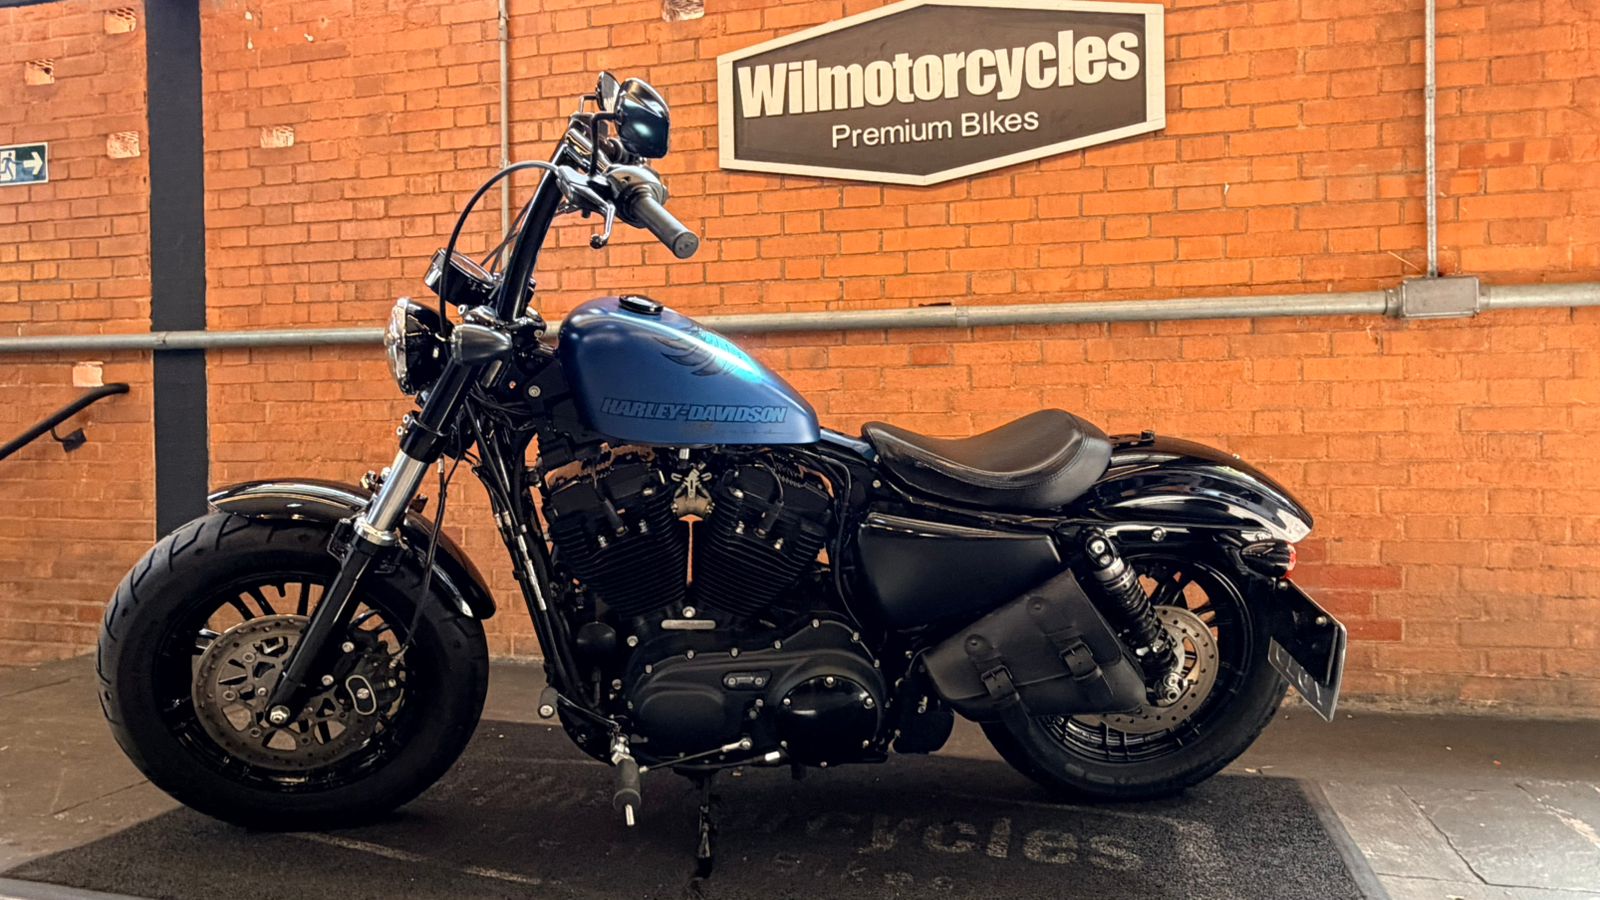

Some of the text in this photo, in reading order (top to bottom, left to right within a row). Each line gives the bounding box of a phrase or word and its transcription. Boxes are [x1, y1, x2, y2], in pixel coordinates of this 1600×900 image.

[737, 30, 1140, 118] Wilmotorcycles
[831, 118, 953, 148] Premium
[601, 397, 788, 423] HARLEY-DAVIDSON
